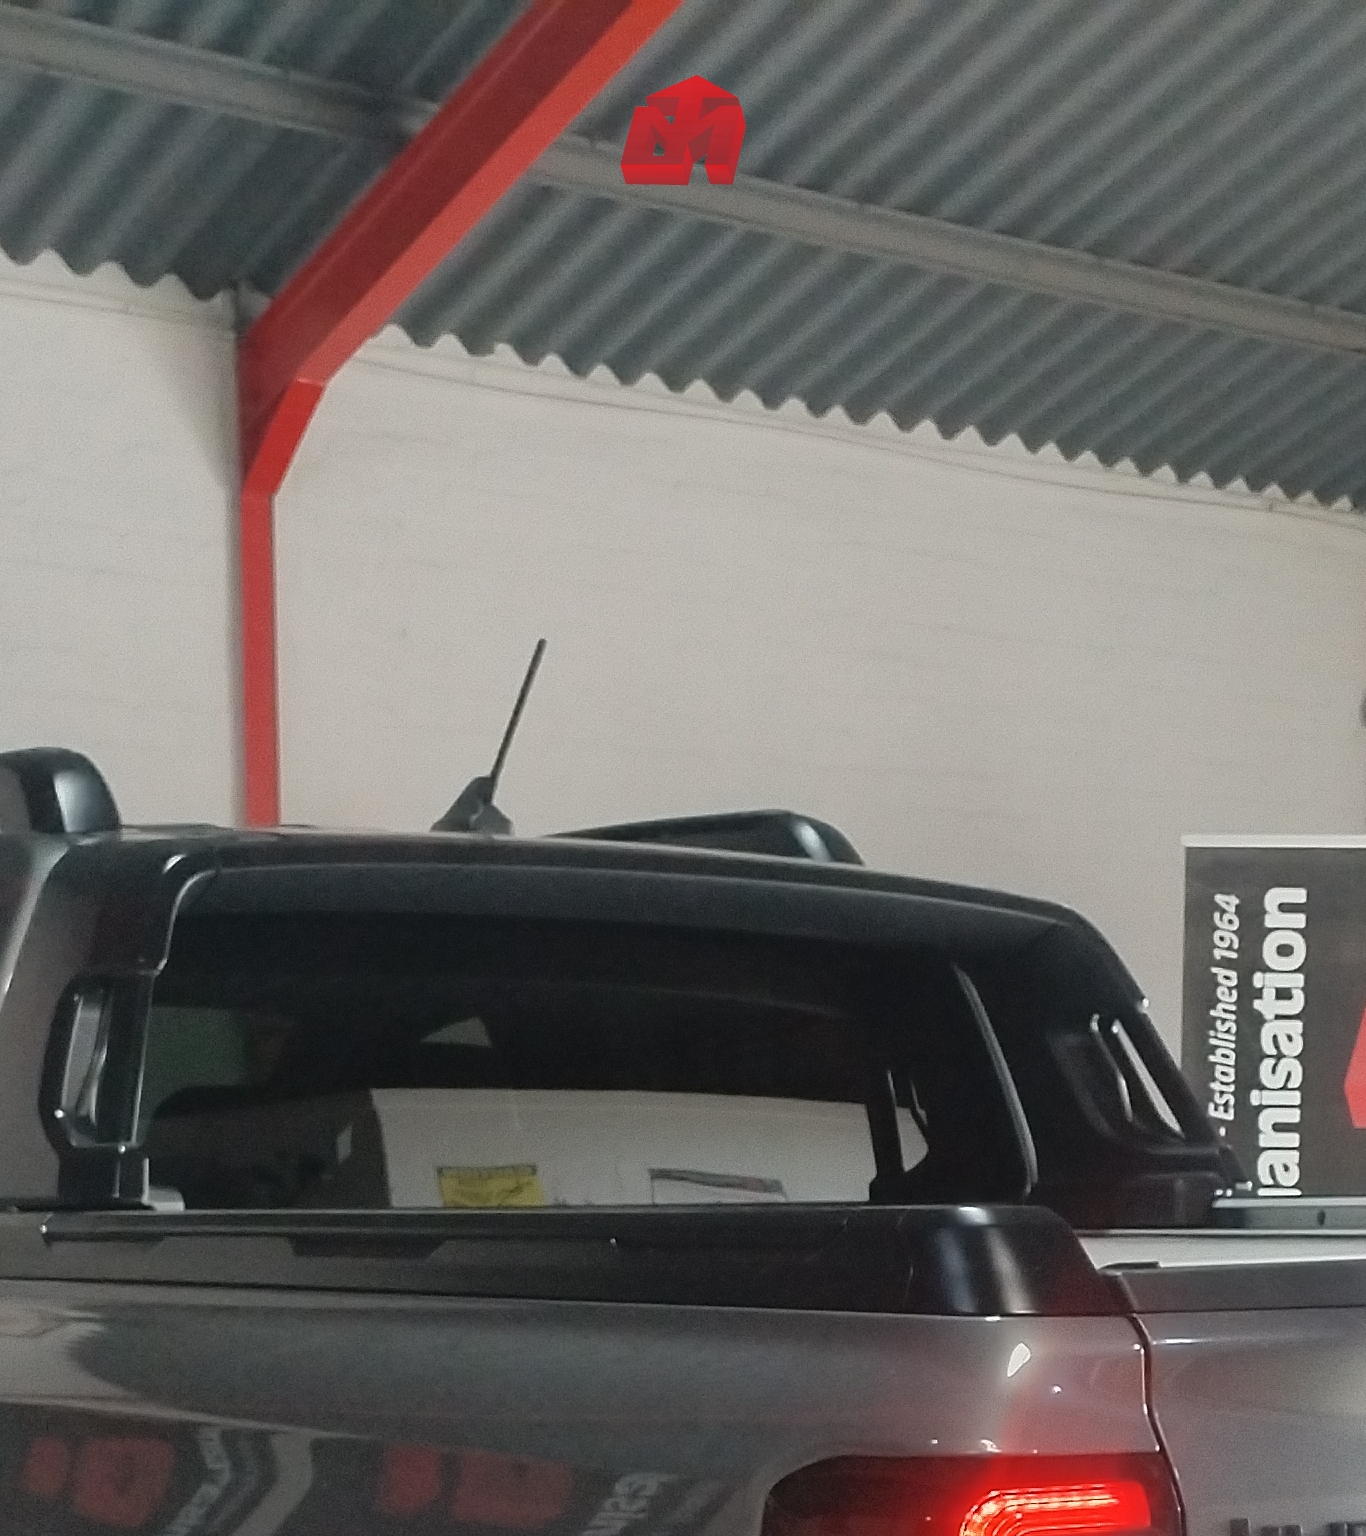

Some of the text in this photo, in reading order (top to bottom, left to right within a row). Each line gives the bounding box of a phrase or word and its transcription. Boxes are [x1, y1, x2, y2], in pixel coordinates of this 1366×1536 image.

[1211, 893, 1240, 961] 1964
[1208, 966, 1238, 1122] Established
[1249, 886, 1308, 1196] anisation
